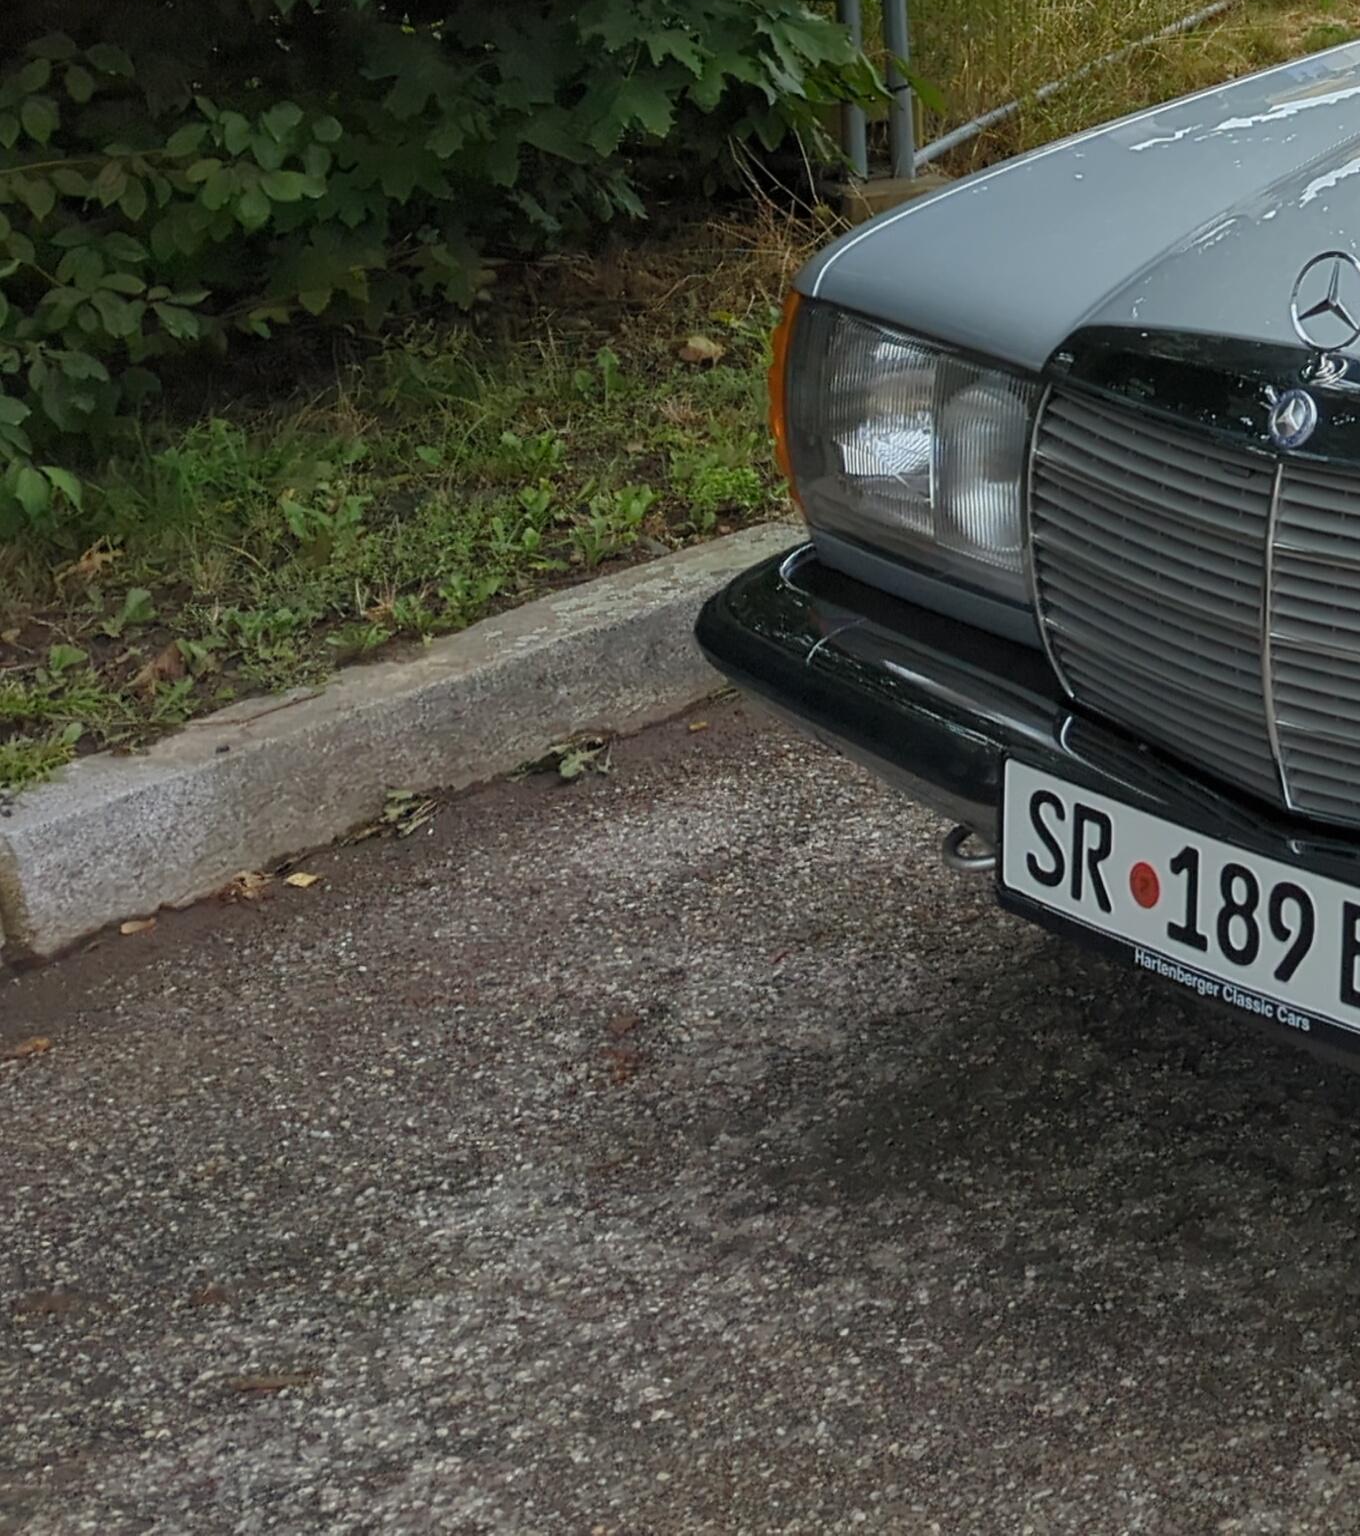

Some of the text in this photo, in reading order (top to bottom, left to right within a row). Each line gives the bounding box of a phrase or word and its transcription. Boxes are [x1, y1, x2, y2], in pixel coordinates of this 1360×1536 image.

[1026, 788, 1113, 914] SR
[1166, 844, 1316, 983] 189
[1133, 949, 1311, 1032] Hartenberger Classic Cars
